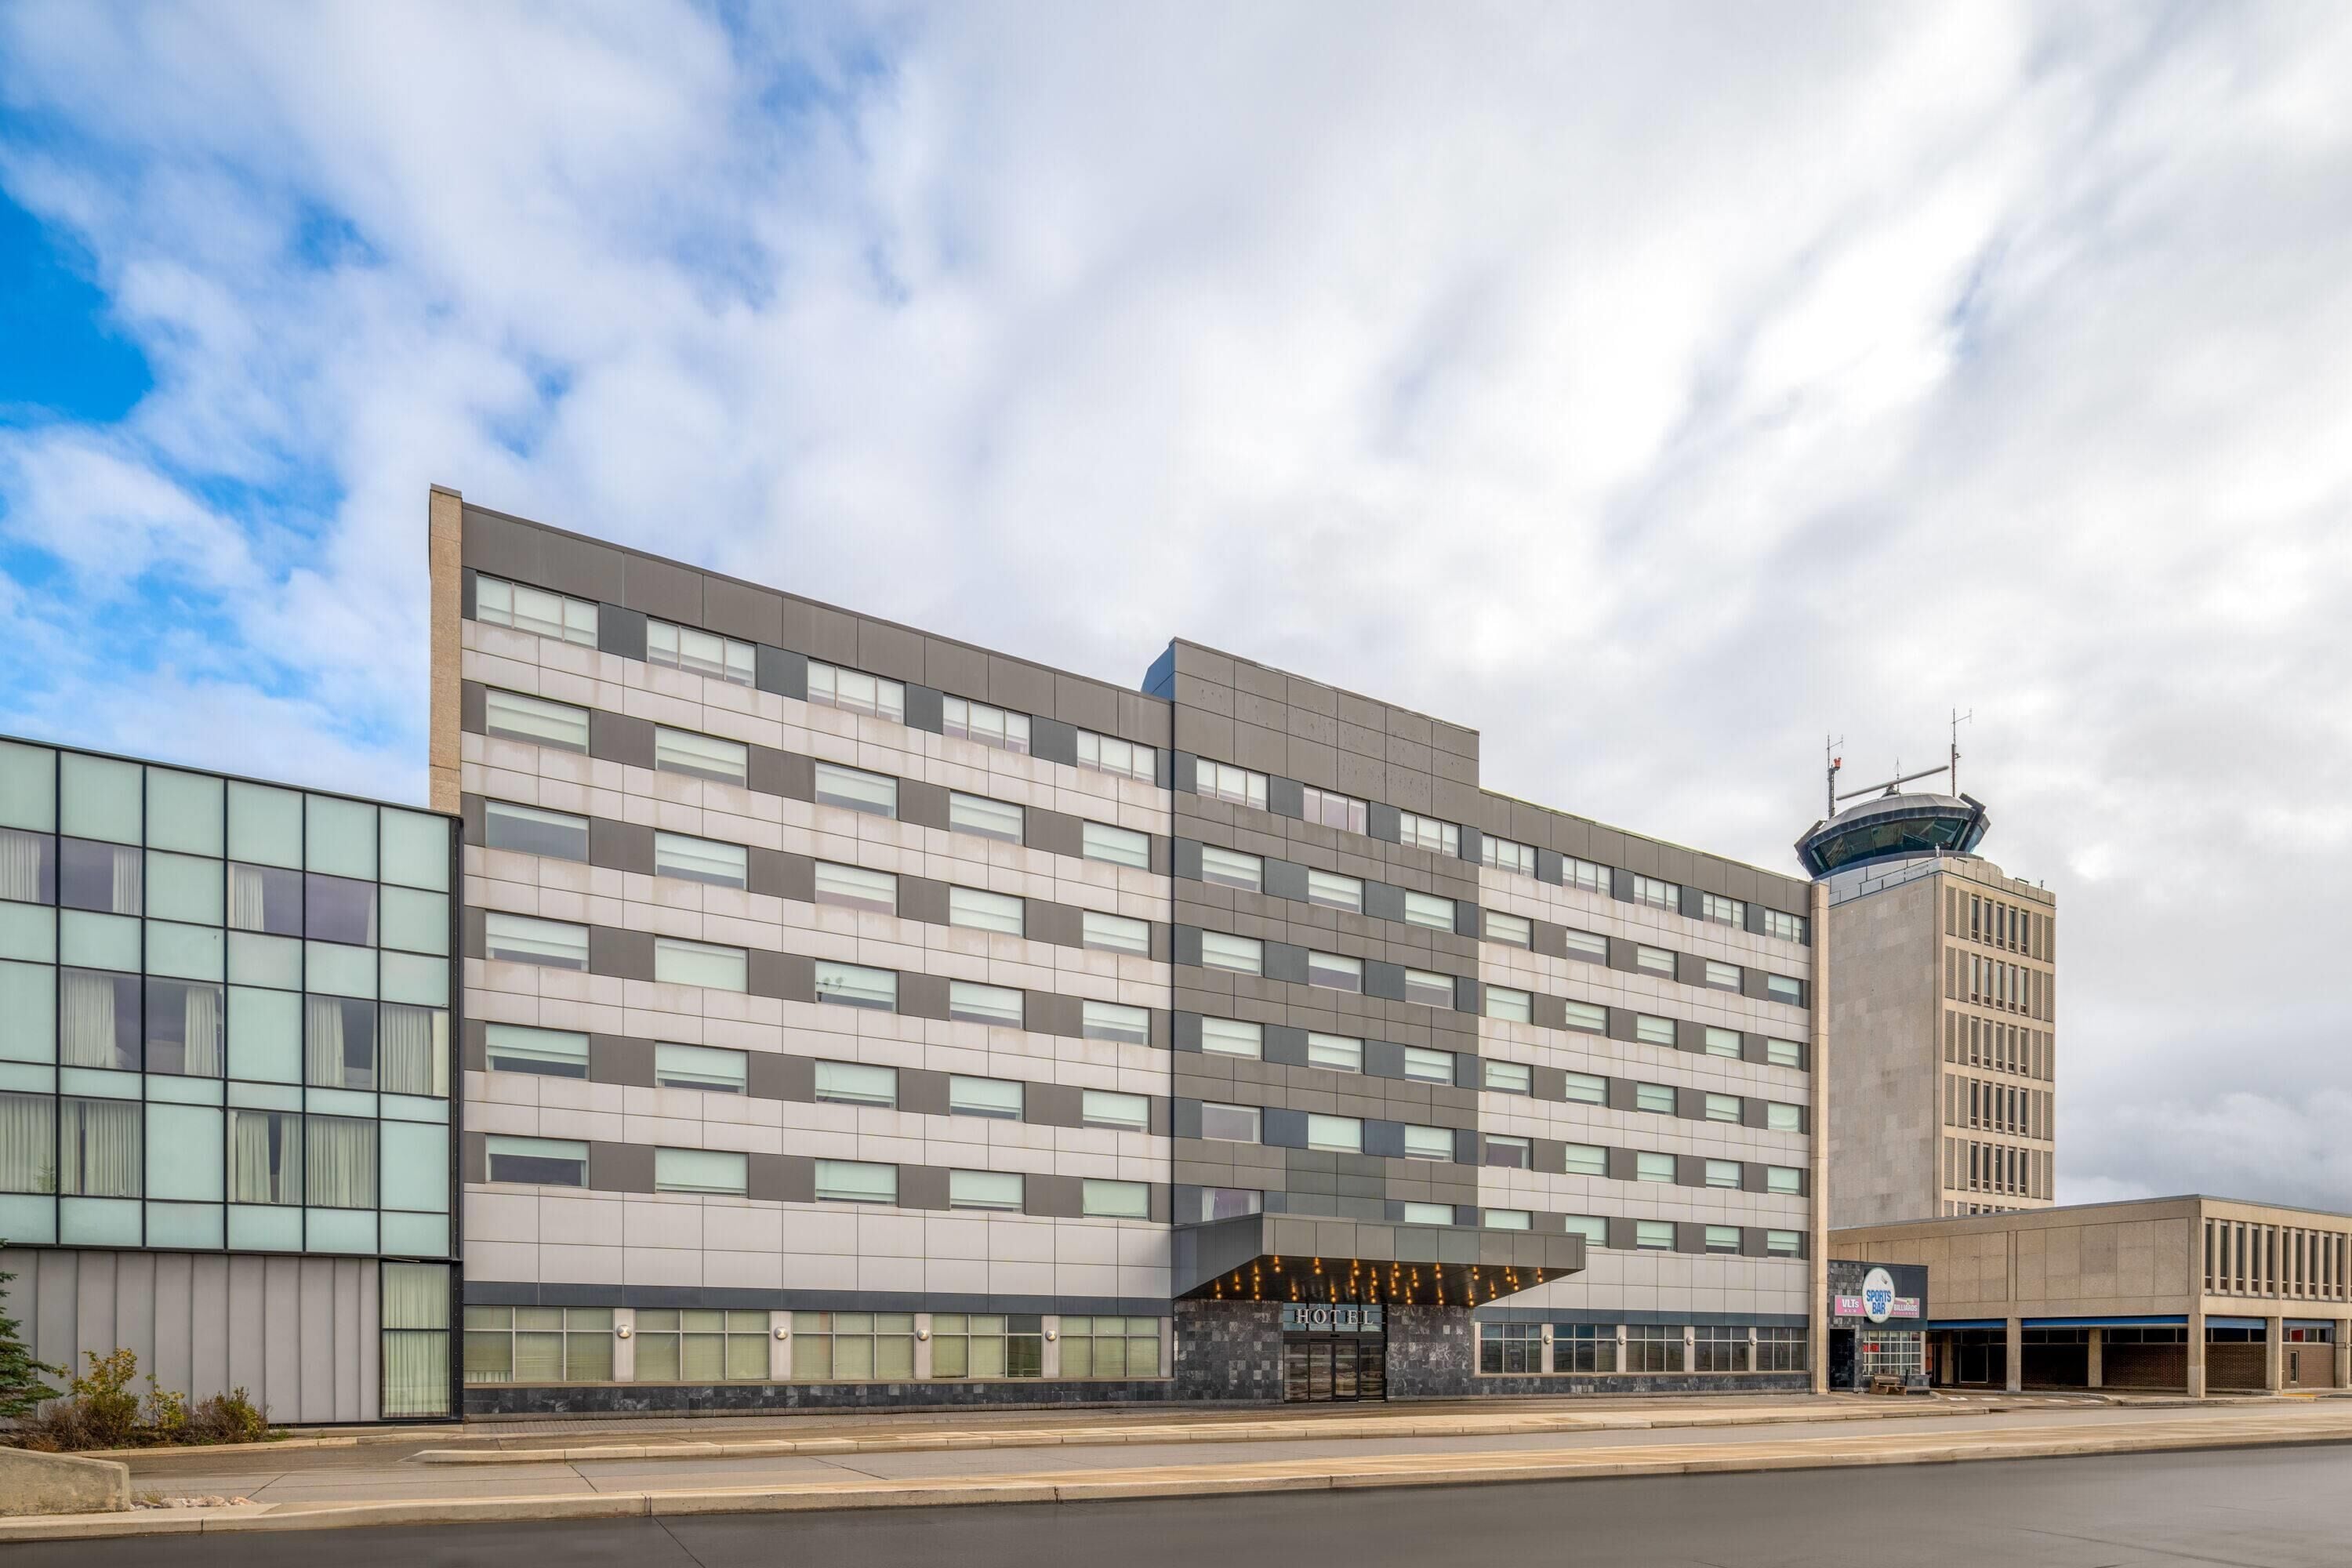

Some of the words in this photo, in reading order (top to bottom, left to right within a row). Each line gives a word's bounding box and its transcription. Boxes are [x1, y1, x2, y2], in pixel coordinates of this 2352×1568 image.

[1866, 1290, 1892, 1302] SPORTS
[1842, 1298, 1860, 1308] VLTs
[1872, 1302, 1886, 1315] BAR
[1297, 1308, 1374, 1324] HOTEL
